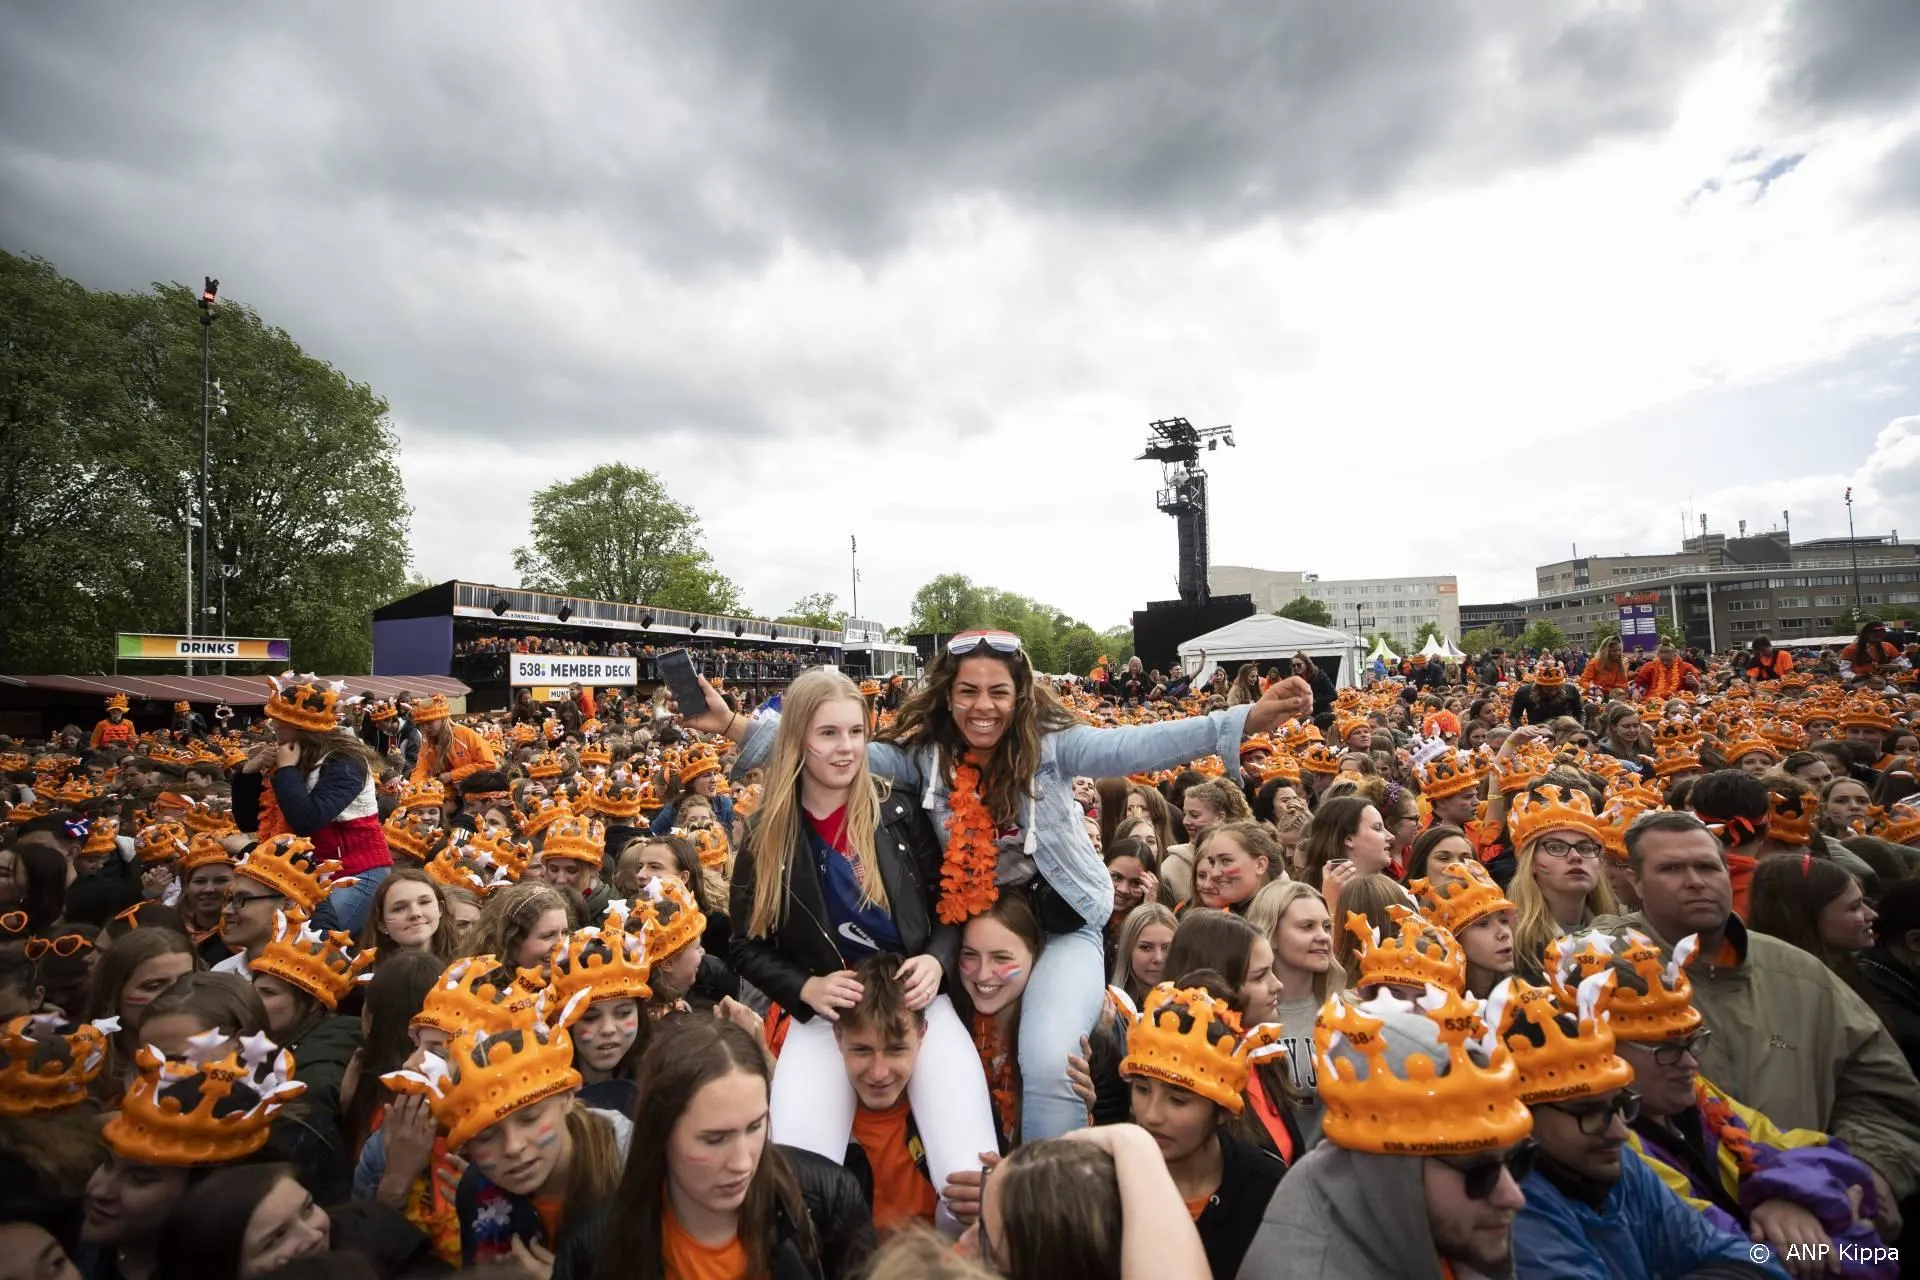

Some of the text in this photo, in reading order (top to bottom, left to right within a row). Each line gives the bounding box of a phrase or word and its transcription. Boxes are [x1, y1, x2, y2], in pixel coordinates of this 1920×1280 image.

[181, 643, 235, 654] DRINKS
[550, 663, 601, 677] MEMBER
[605, 664, 631, 677] DECK
[551, 690, 570, 698] MUNT
[591, 989, 628, 1001] NINGSDAG
[1277, 1037, 1317, 1088] Y J
